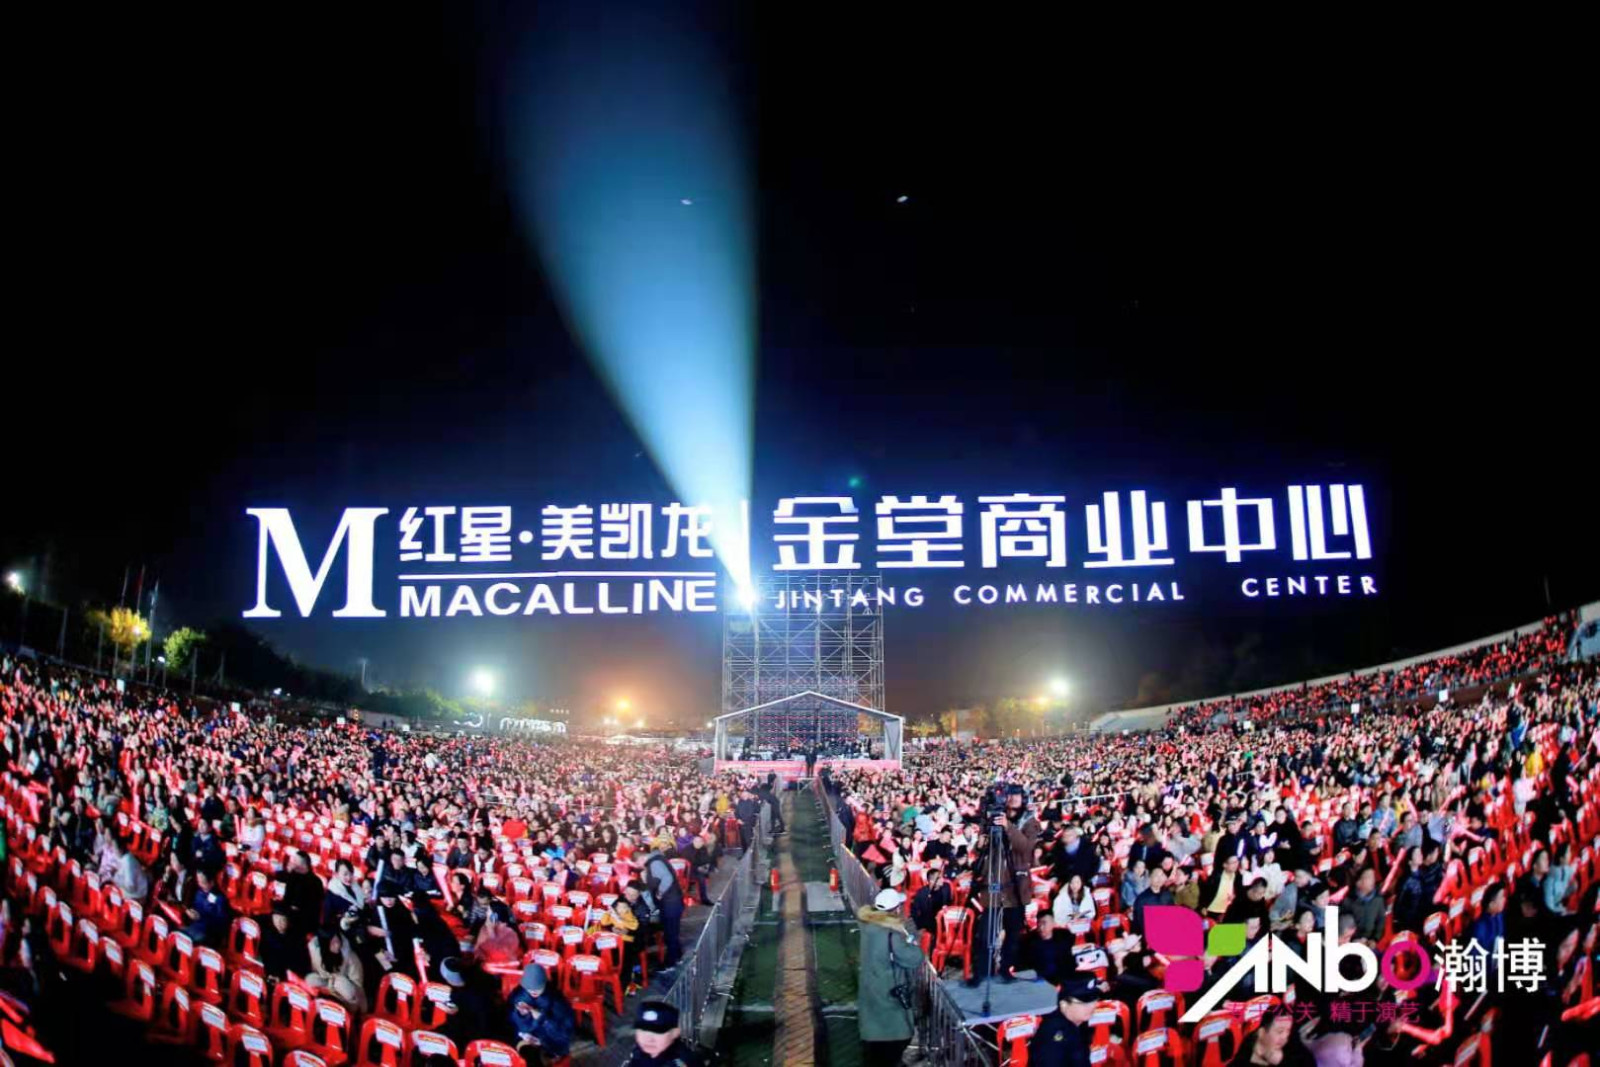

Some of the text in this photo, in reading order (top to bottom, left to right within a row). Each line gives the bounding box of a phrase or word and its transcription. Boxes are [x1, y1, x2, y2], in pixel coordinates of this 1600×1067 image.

[772, 484, 1372, 571] 金堂商业中心
[242, 507, 389, 618] M
[774, 575, 1378, 611] JINTANG COMMERCIAL CENTER
[400, 579, 717, 618] MACALLINE
